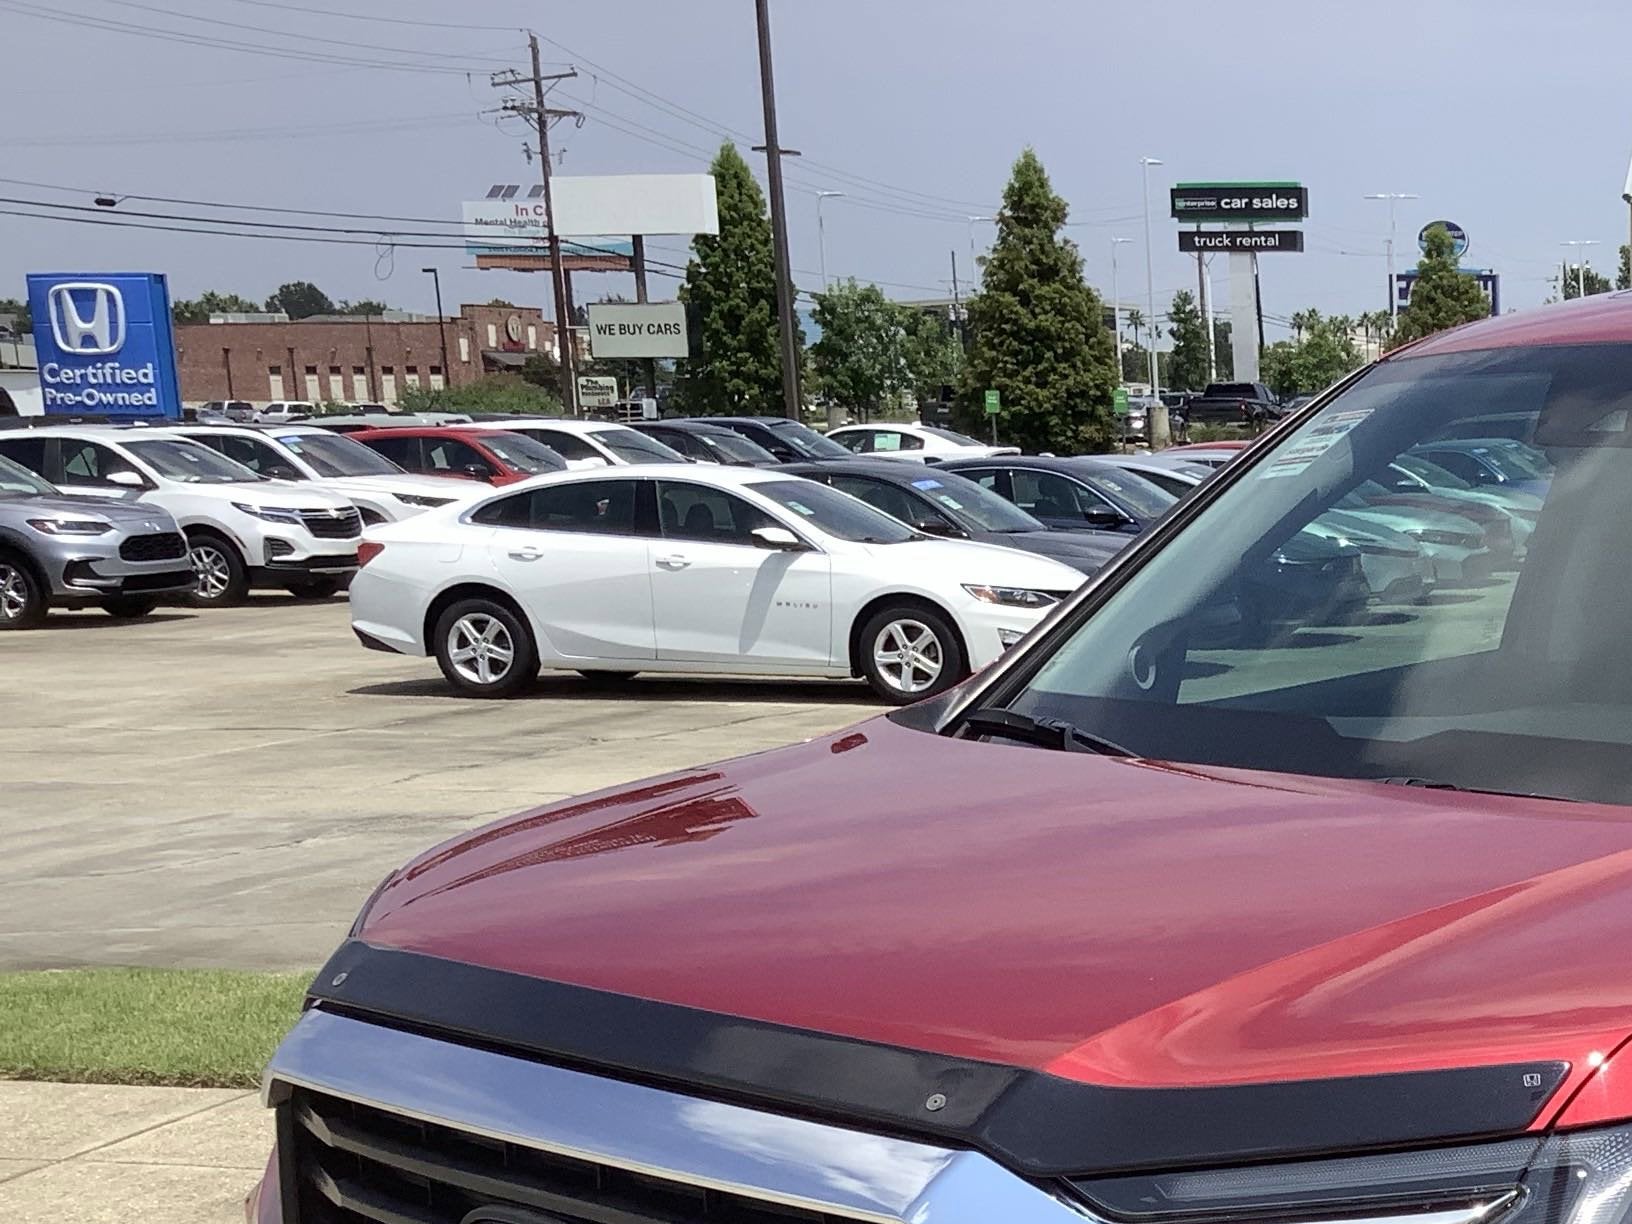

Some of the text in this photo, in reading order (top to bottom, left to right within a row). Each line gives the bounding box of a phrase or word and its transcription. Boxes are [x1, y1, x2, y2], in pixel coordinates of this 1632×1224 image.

[1220, 197, 1249, 209] car
[1252, 193, 1298, 209] sales
[515, 204, 549, 216] In C
[475, 217, 507, 227] Mental
[509, 217, 541, 227] Health
[1194, 233, 1279, 246] truck rental
[595, 322, 681, 336] WE BUY CARS
[43, 361, 155, 385] Certified
[44, 387, 158, 407] Pre-Owned
